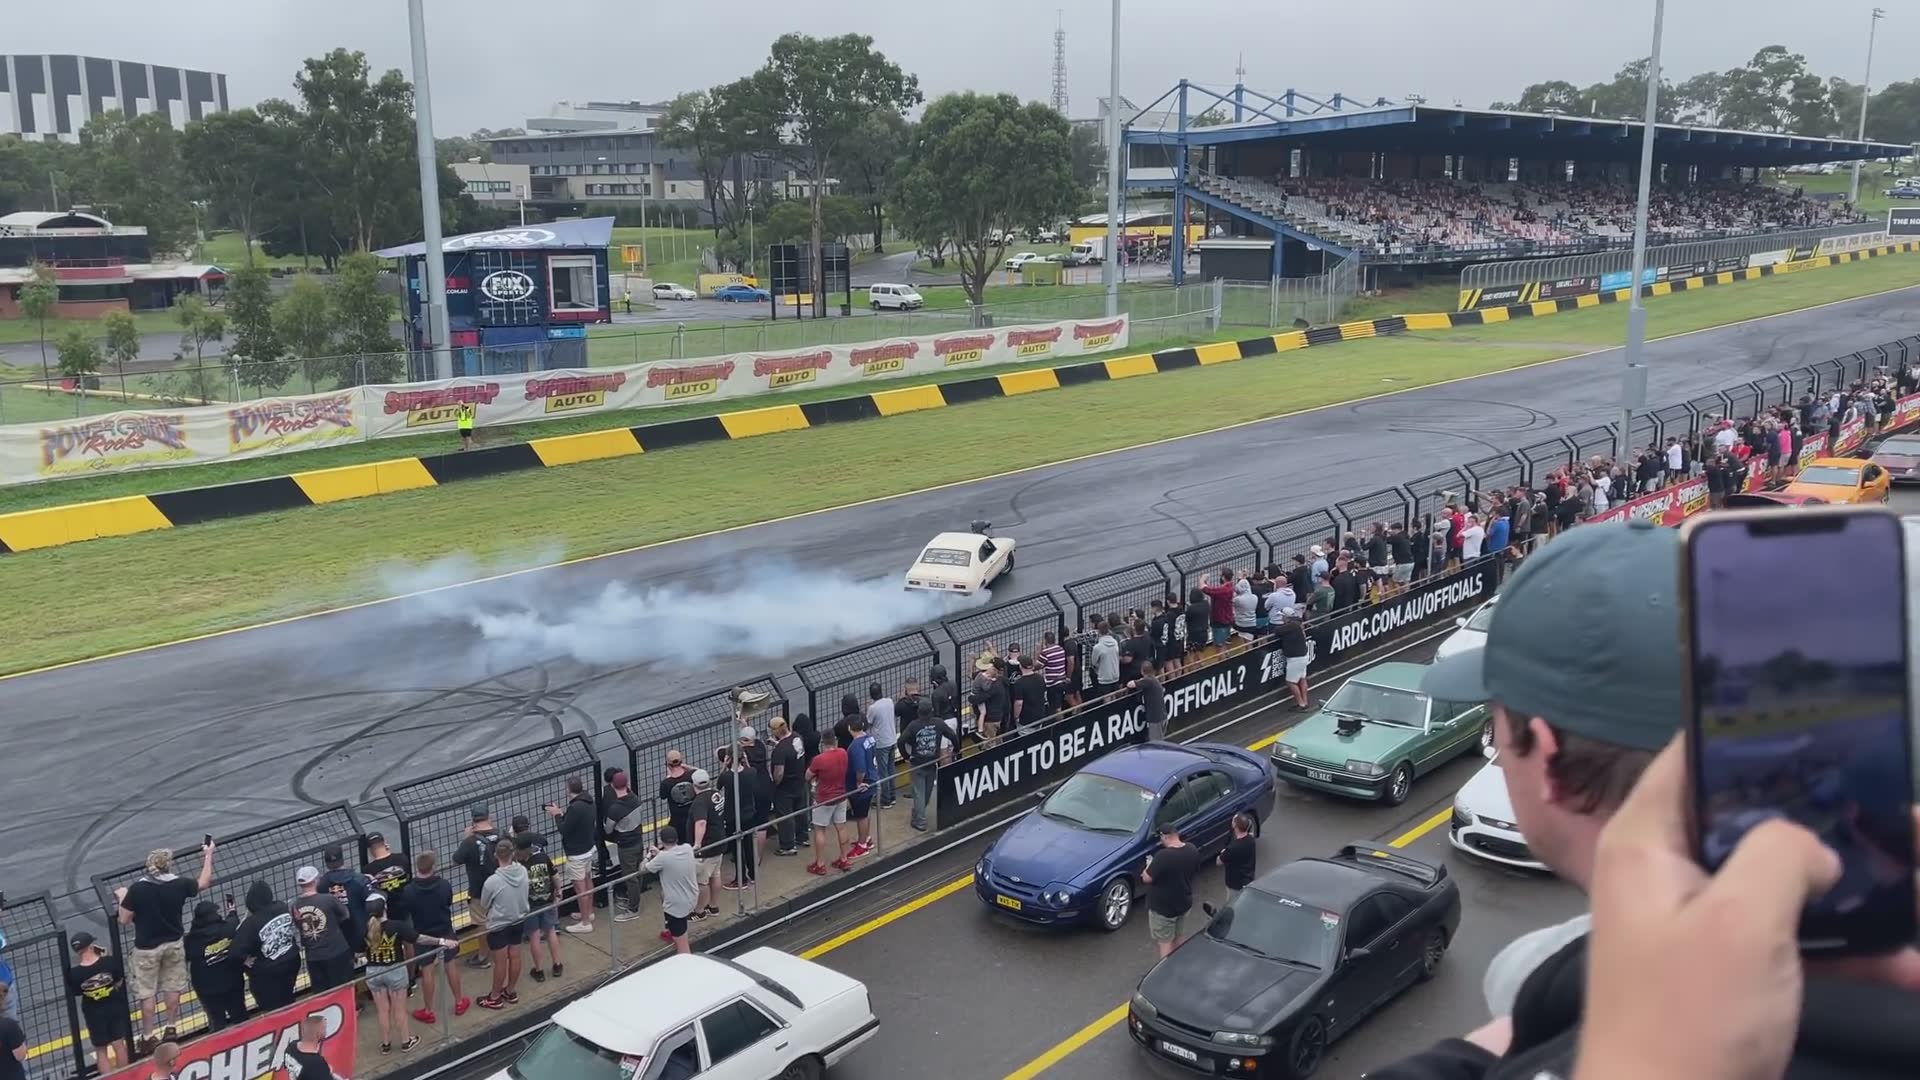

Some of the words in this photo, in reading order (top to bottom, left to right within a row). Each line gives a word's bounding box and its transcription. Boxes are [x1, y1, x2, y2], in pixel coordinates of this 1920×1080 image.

[491, 277, 525, 291] FOX
[1087, 336, 1110, 346] AUTO
[1022, 343, 1046, 353] AUTO
[949, 351, 977, 362] AUTO
[868, 360, 899, 373] AUTO
[775, 371, 809, 384] AUTO
[672, 382, 709, 395] AUTO
[553, 394, 596, 408] AUTO
[417, 406, 471, 421] AUT
[1329, 572, 1483, 654] ARDC.COM.AU/OFFICIALS
[954, 751, 1024, 805] WANT
[1027, 740, 1054, 775] TO
[1059, 727, 1086, 764] BE
[1088, 721, 1104, 751] A
[1107, 697, 1149, 744] RAC
[1164, 665, 1246, 720] OFFICIAL?
